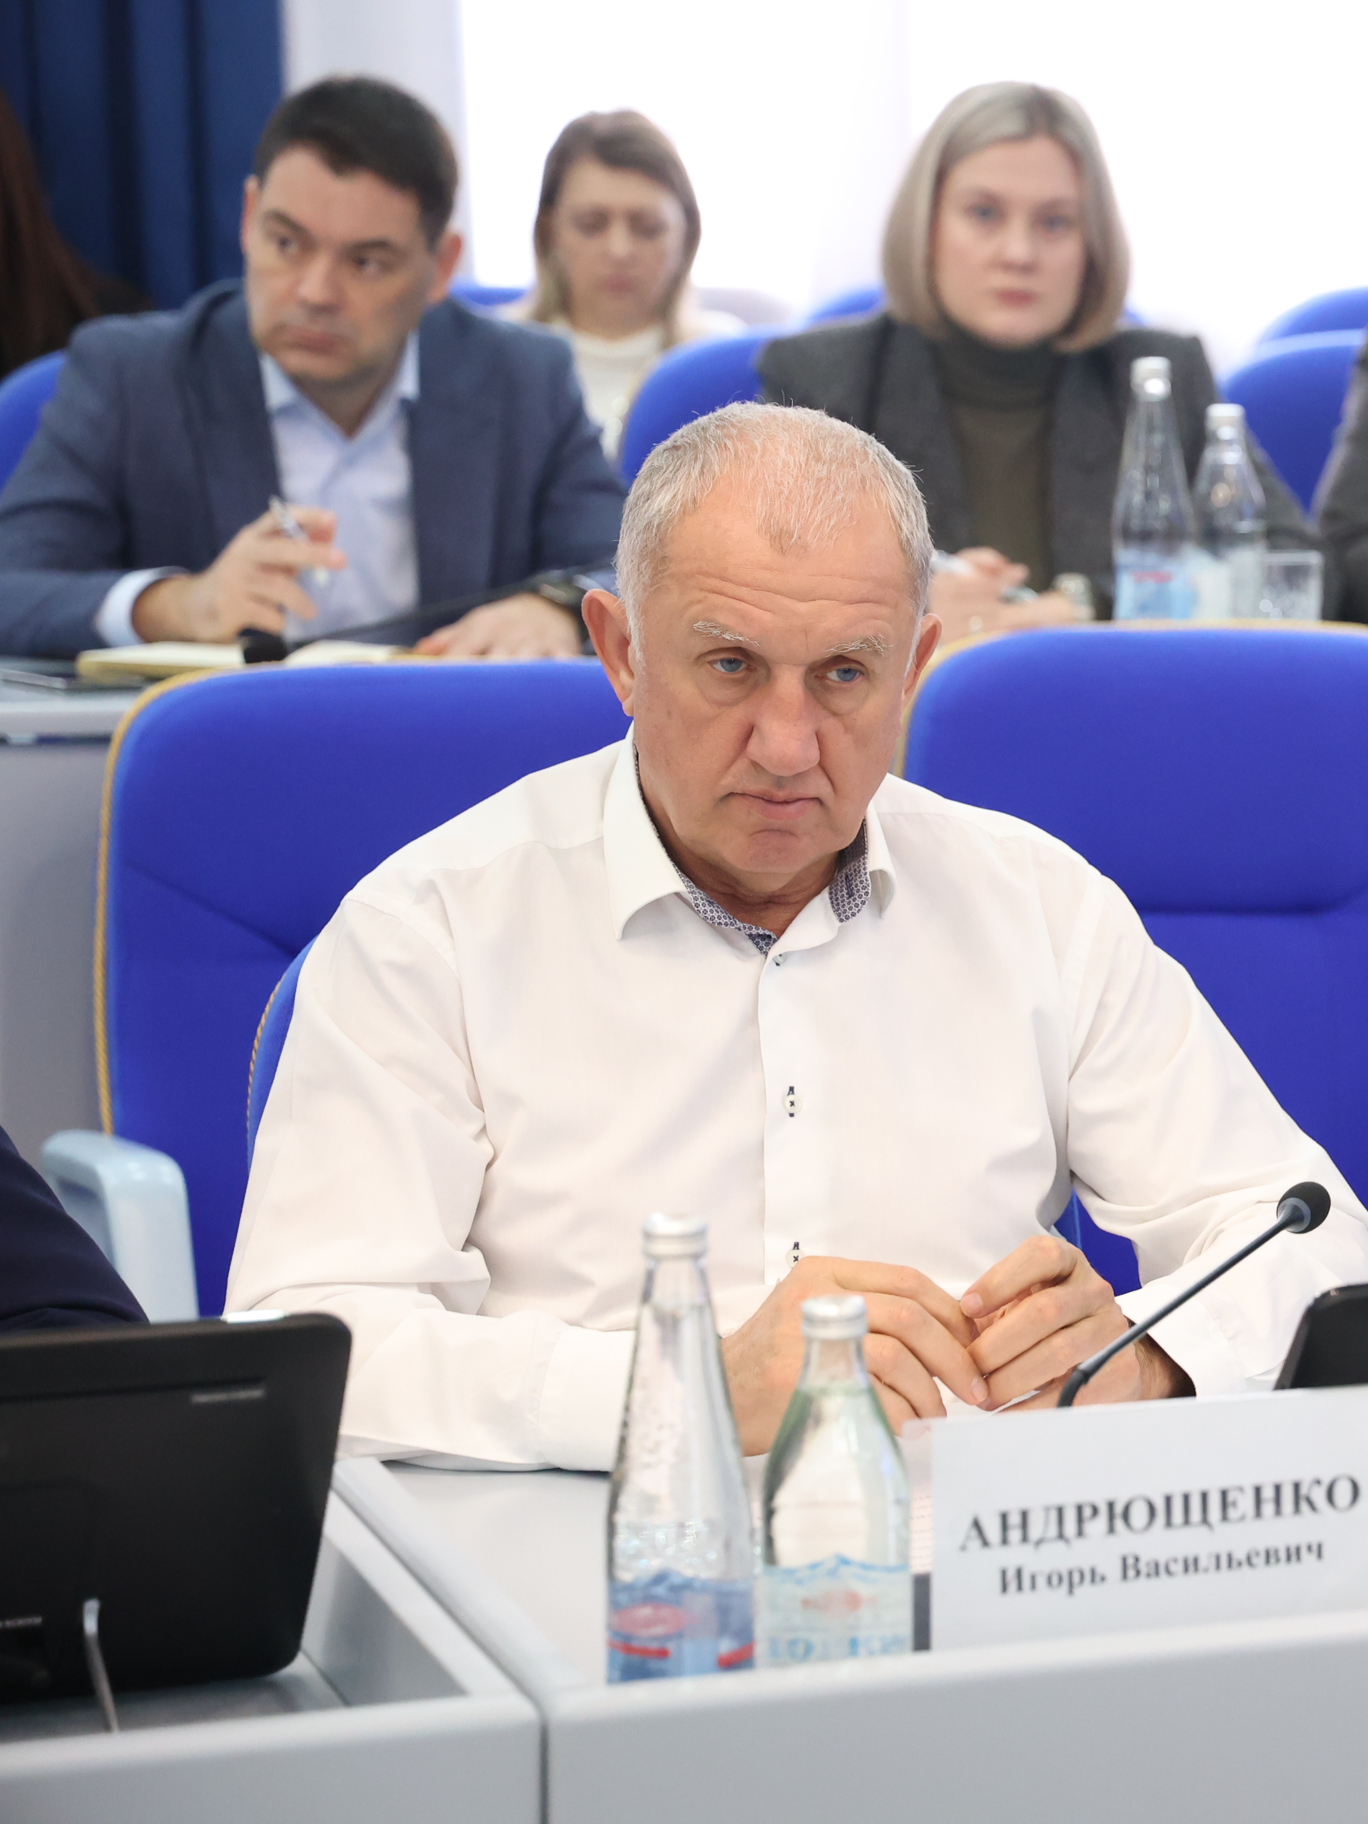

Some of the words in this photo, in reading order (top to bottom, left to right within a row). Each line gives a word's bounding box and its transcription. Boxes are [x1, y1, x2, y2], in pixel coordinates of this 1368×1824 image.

[959, 1474, 1362, 1551] АНДРЮЩЕНКО
[999, 1566, 1107, 1597] Игорь
[1119, 1541, 1325, 1583] Васильевич
